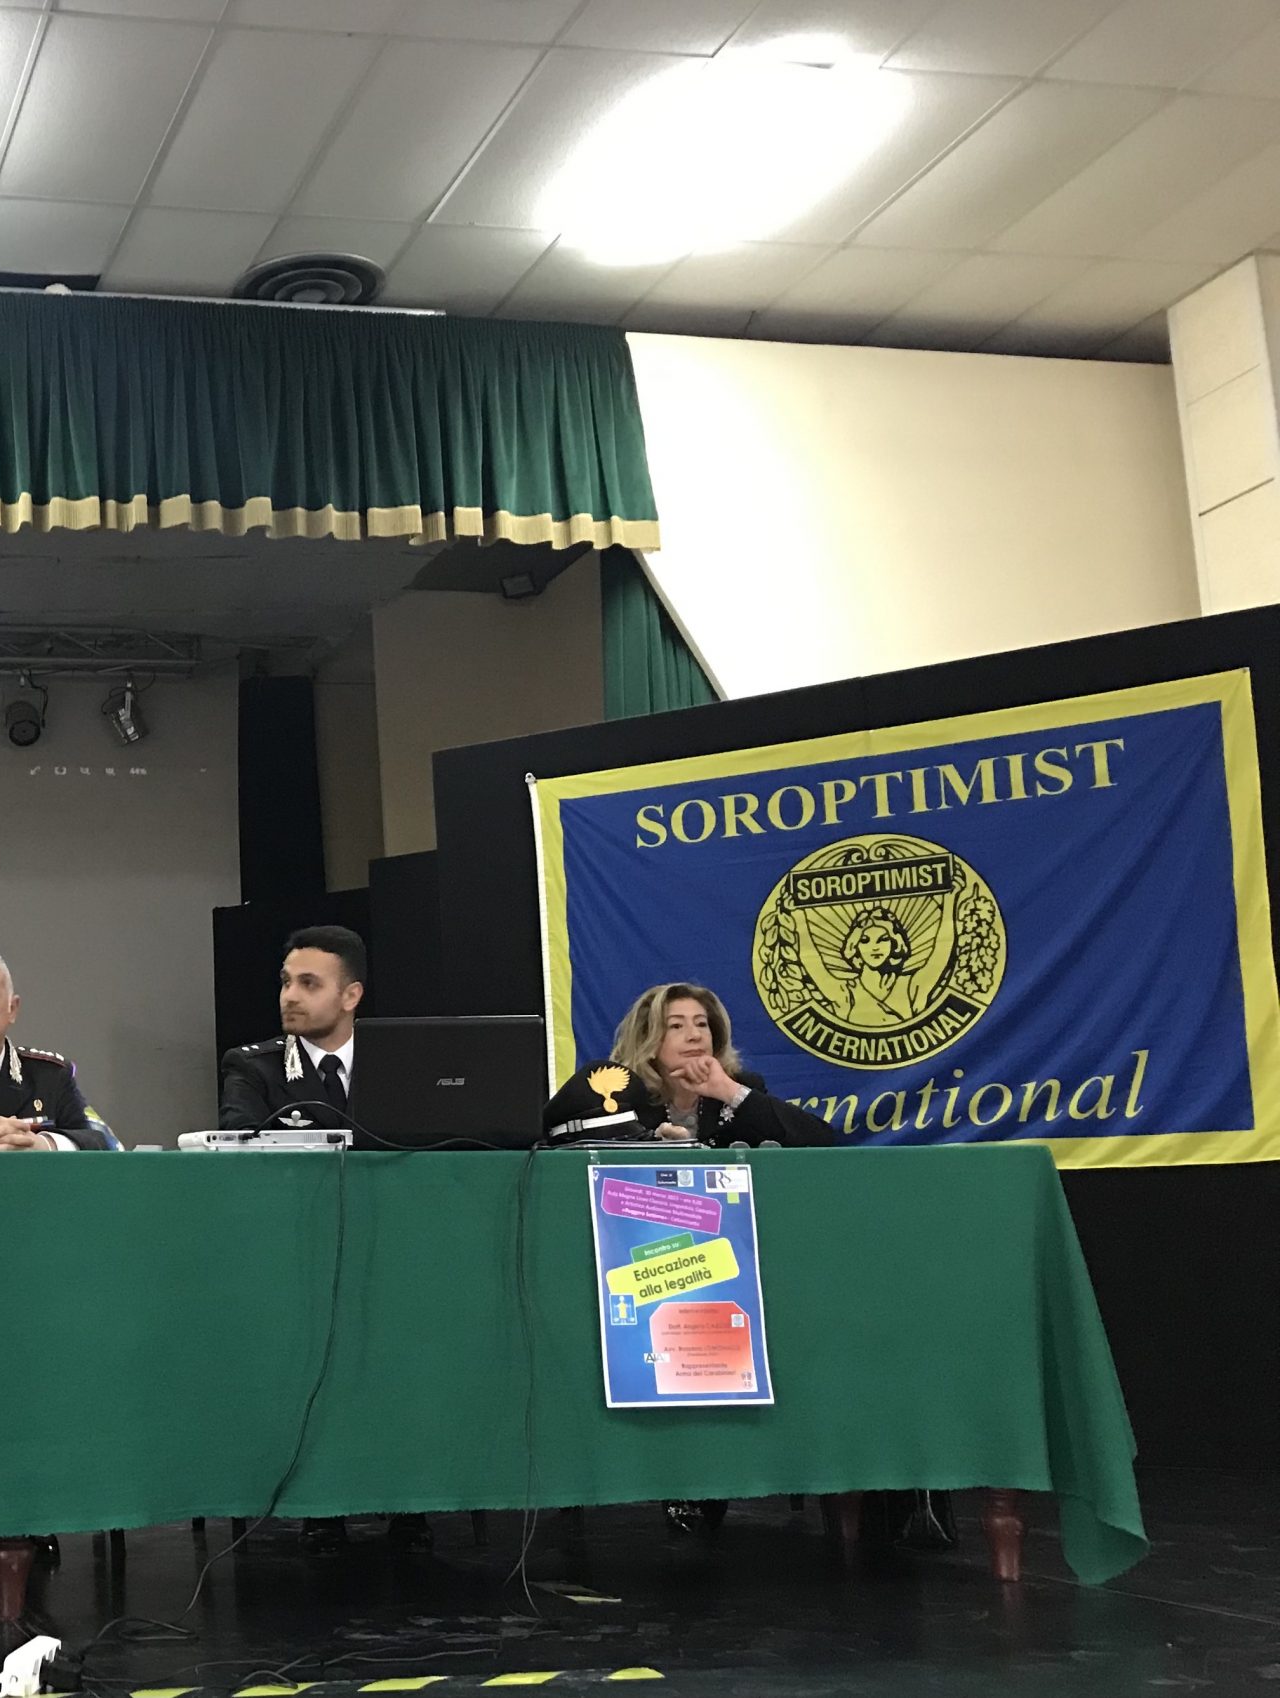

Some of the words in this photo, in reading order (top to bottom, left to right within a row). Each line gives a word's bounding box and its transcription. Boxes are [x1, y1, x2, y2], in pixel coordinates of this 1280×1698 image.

[635, 738, 1125, 848] SOROPTIMIST
[796, 862, 946, 900] SOROPTIMIST
[791, 1006, 972, 1062] INTERNATIONAL
[436, 1078, 465, 1086] ASUS
[785, 1050, 1149, 1134] rnational
[633, 1253, 706, 1281] Educazione
[644, 1245, 671, 1256] Incontro
[639, 1284, 662, 1298] alla
[664, 1267, 712, 1290] legalità
